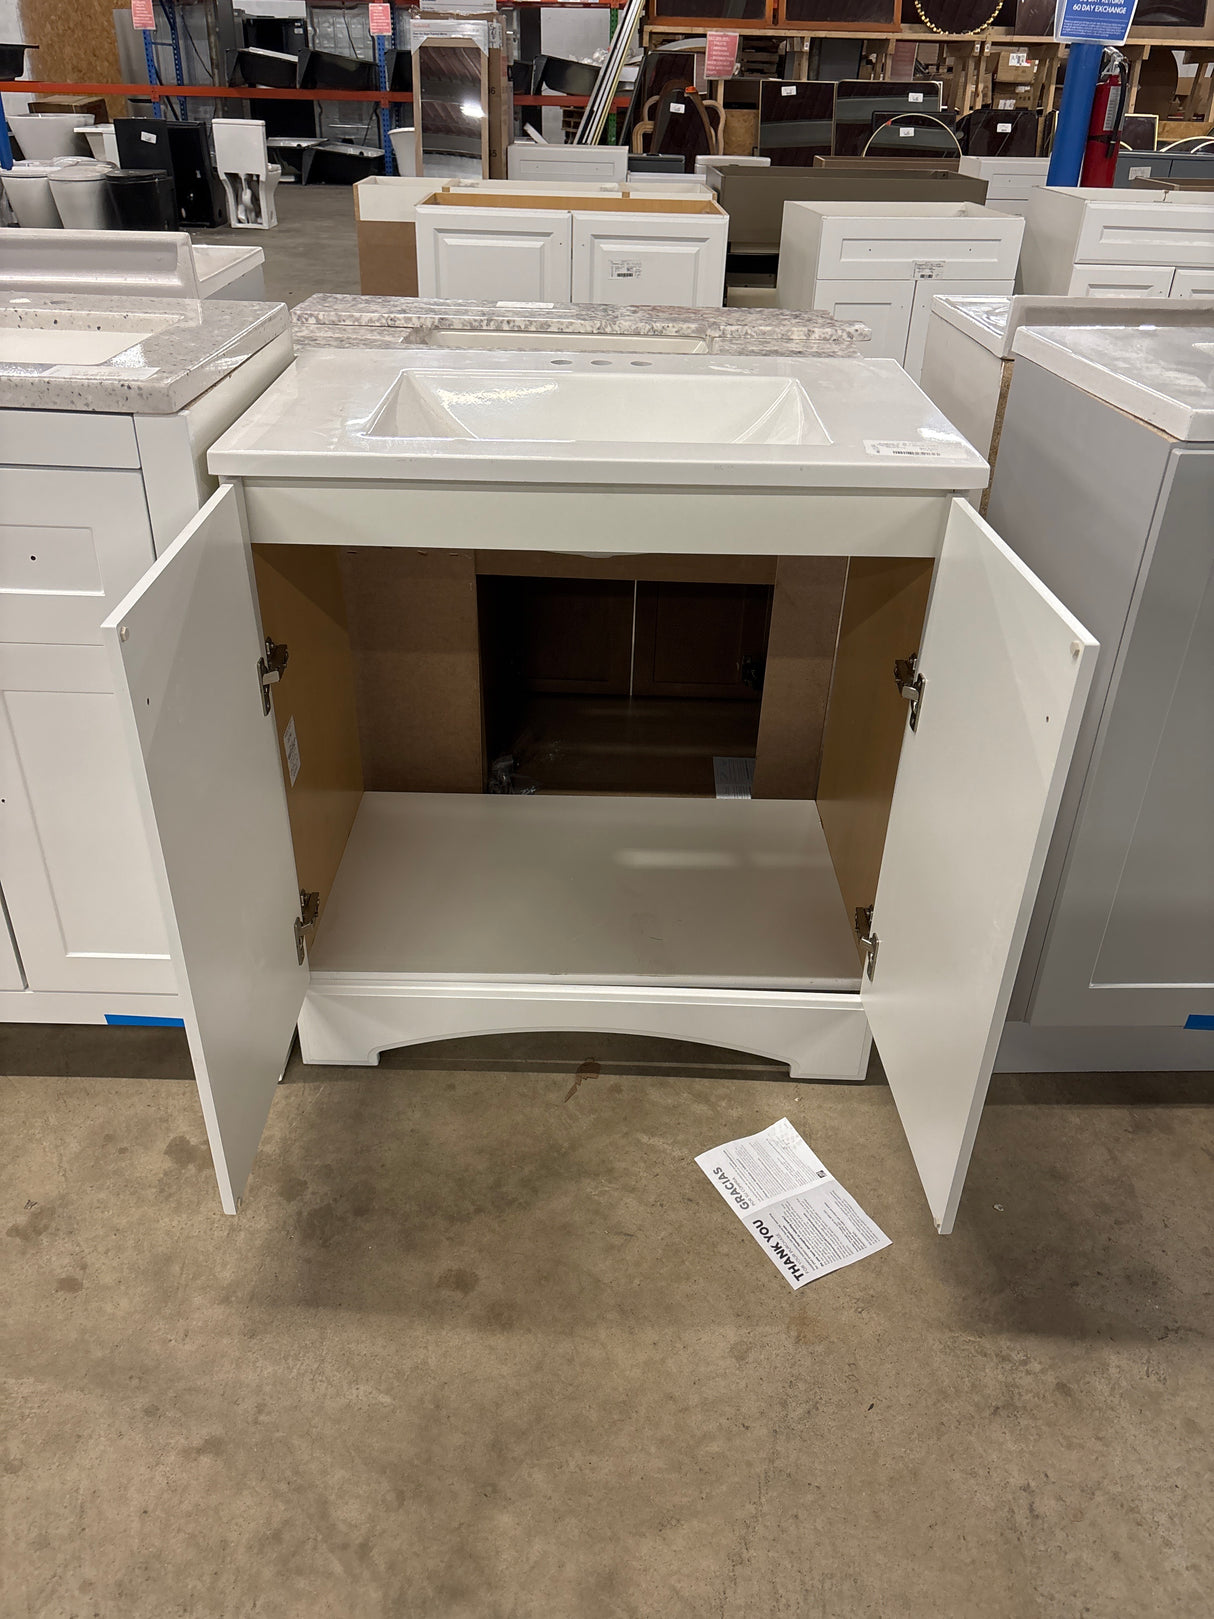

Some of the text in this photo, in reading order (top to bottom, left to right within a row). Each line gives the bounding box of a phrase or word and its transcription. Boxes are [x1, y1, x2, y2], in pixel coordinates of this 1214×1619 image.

[1072, 3, 1127, 15] 60 DAY EXCHANGE
[713, 1166, 749, 1210] GRACIAS
[752, 1219, 804, 1282] THANK YOU
